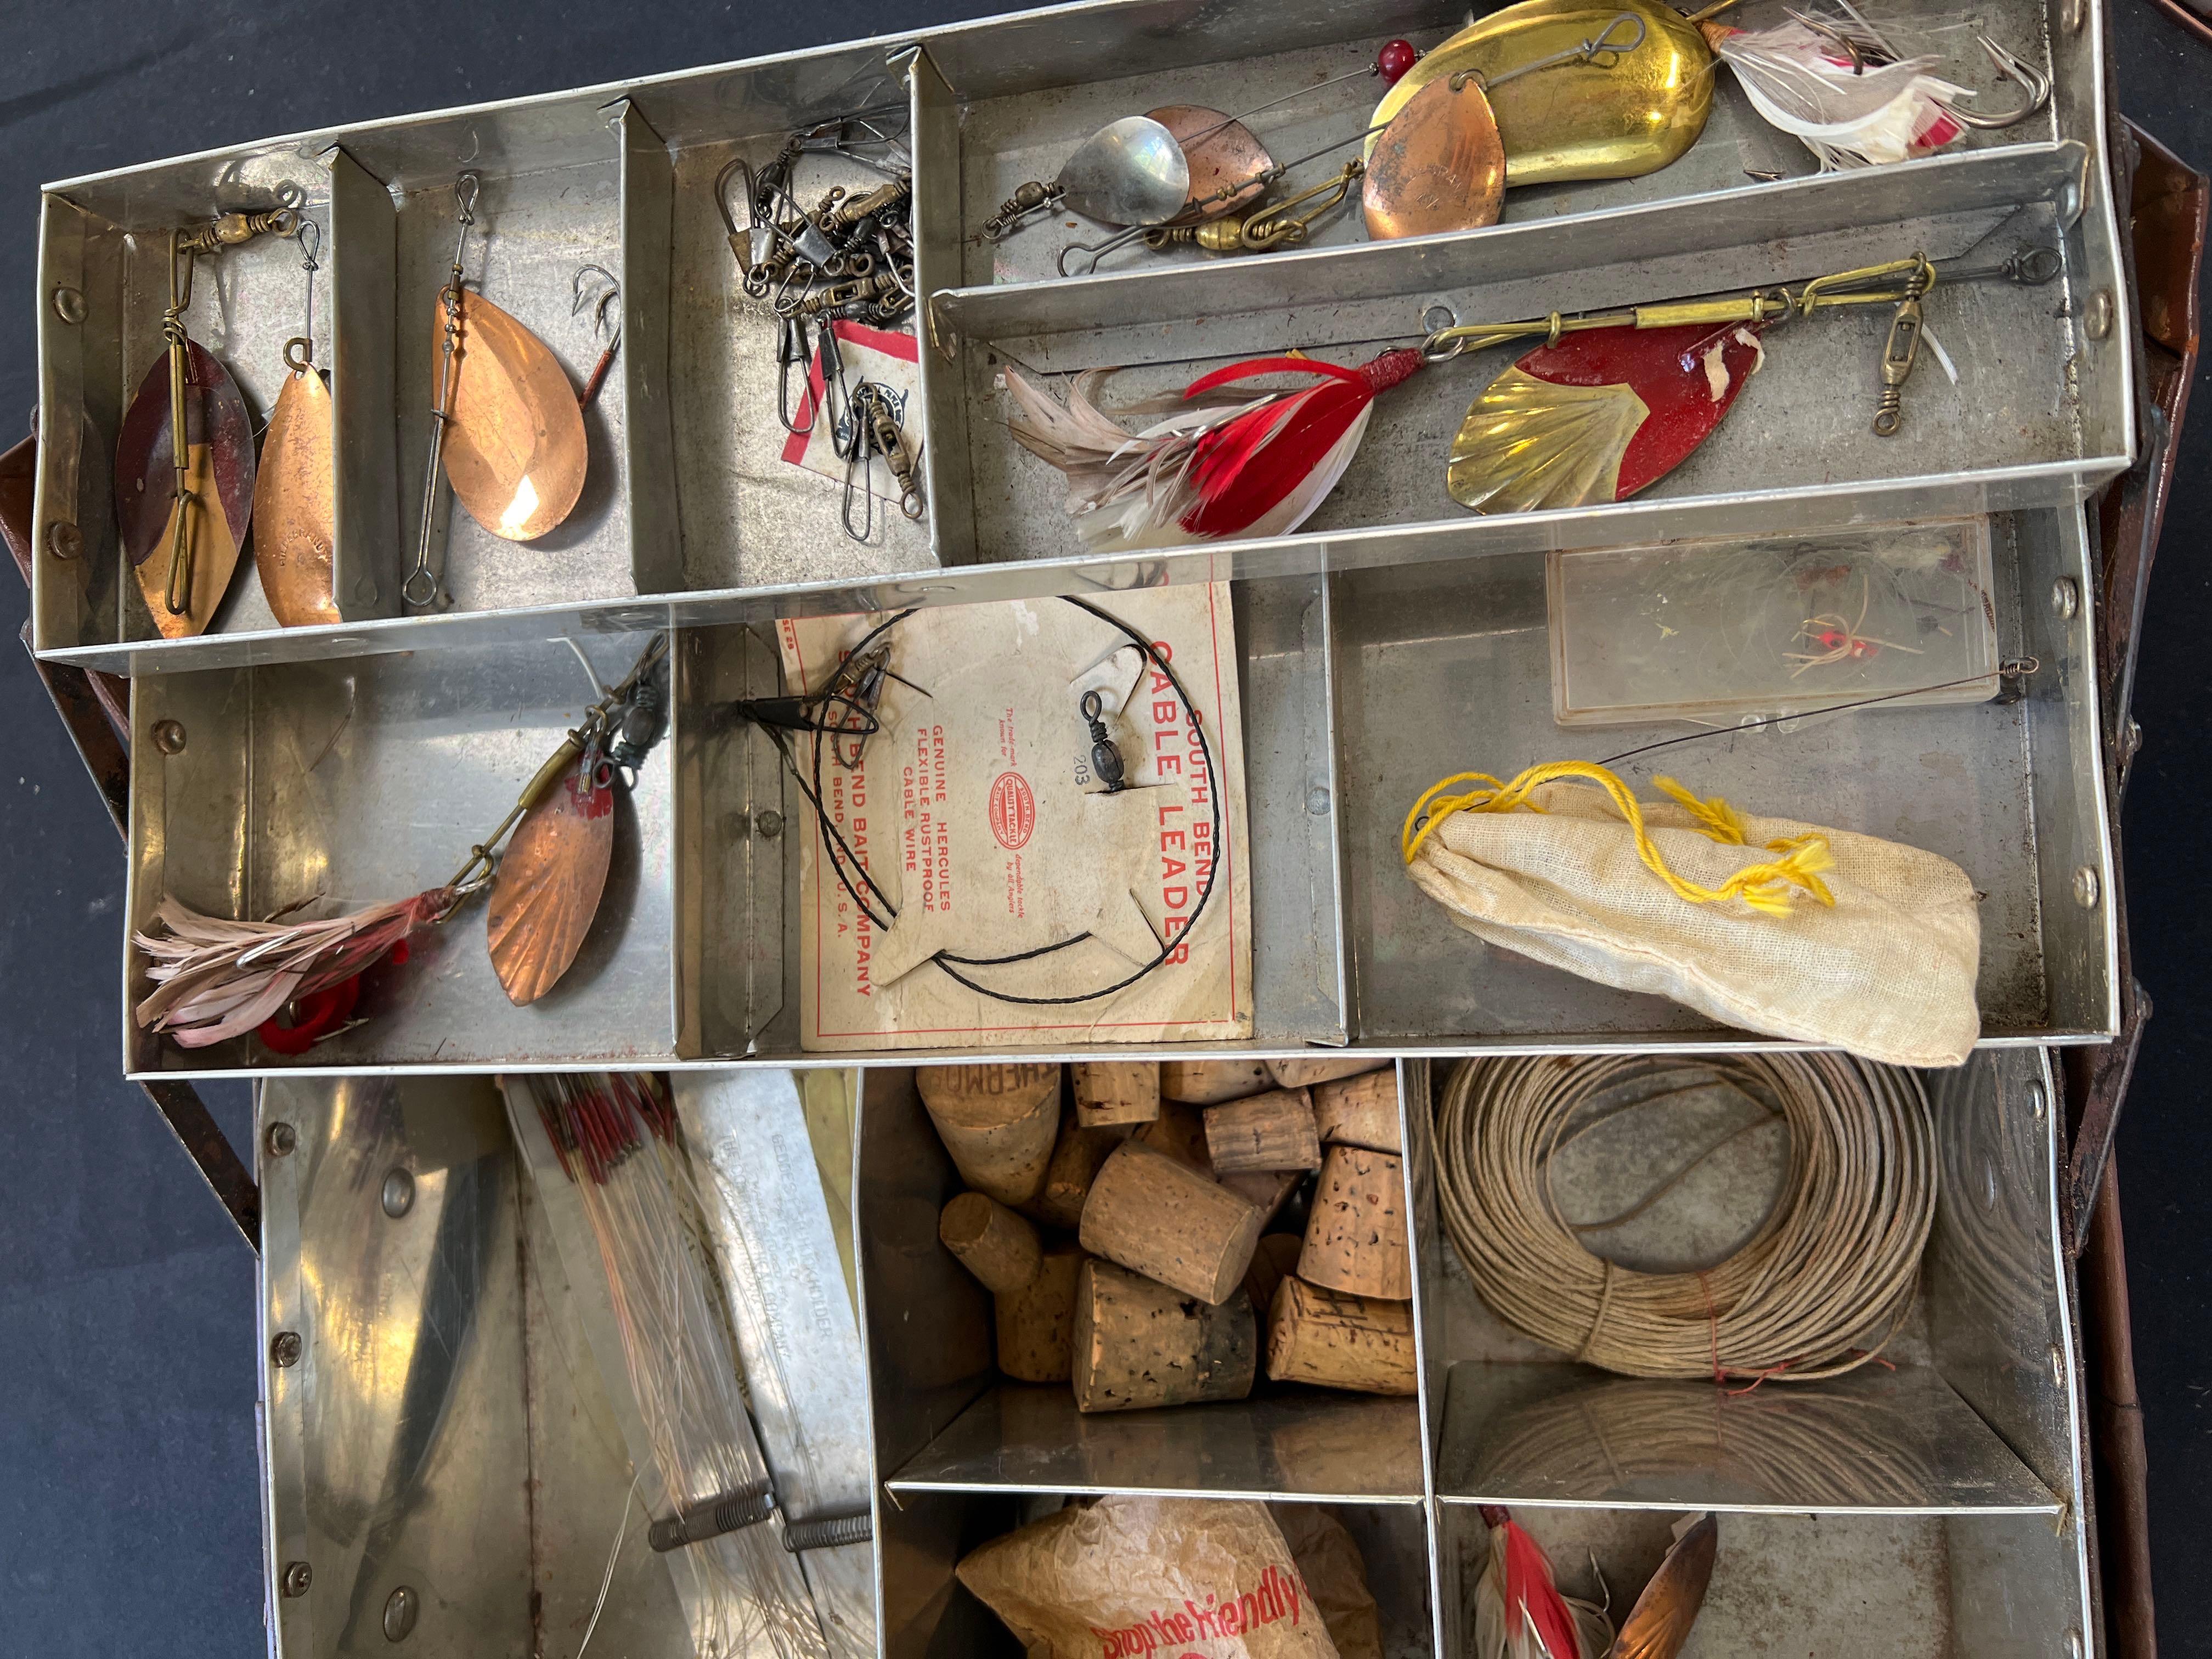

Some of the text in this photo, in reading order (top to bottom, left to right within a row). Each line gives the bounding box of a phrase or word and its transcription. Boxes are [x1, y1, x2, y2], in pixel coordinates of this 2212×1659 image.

[1008, 726, 1017, 766] trade-mark
[1074, 755, 1090, 785] 203
[833, 777, 844, 828] BEND,
[849, 744, 866, 807] BEND
[1020, 787, 1030, 811] SOUTH
[1148, 641, 1189, 966] CABLE LEADER
[1186, 710, 1212, 896] SOUTH BEND
[904, 766, 916, 871] CABLE WIRE
[917, 728, 934, 912] FLEXIBLE RUSTPROOF
[933, 725, 951, 911] GENUINE HERCULES
[994, 804, 1004, 834] COMPANY
[1006, 779, 1017, 843] QUALITY TACKLE
[853, 818, 869, 871] BAIT
[1006, 861, 1014, 871] by
[1007, 886, 1015, 913] Anglers
[1015, 854, 1024, 894] dependable
[856, 880, 871, 997] COMPANY
[1148, 1610, 1195, 1646] the
[1184, 1564, 1299, 1642] Friendly
